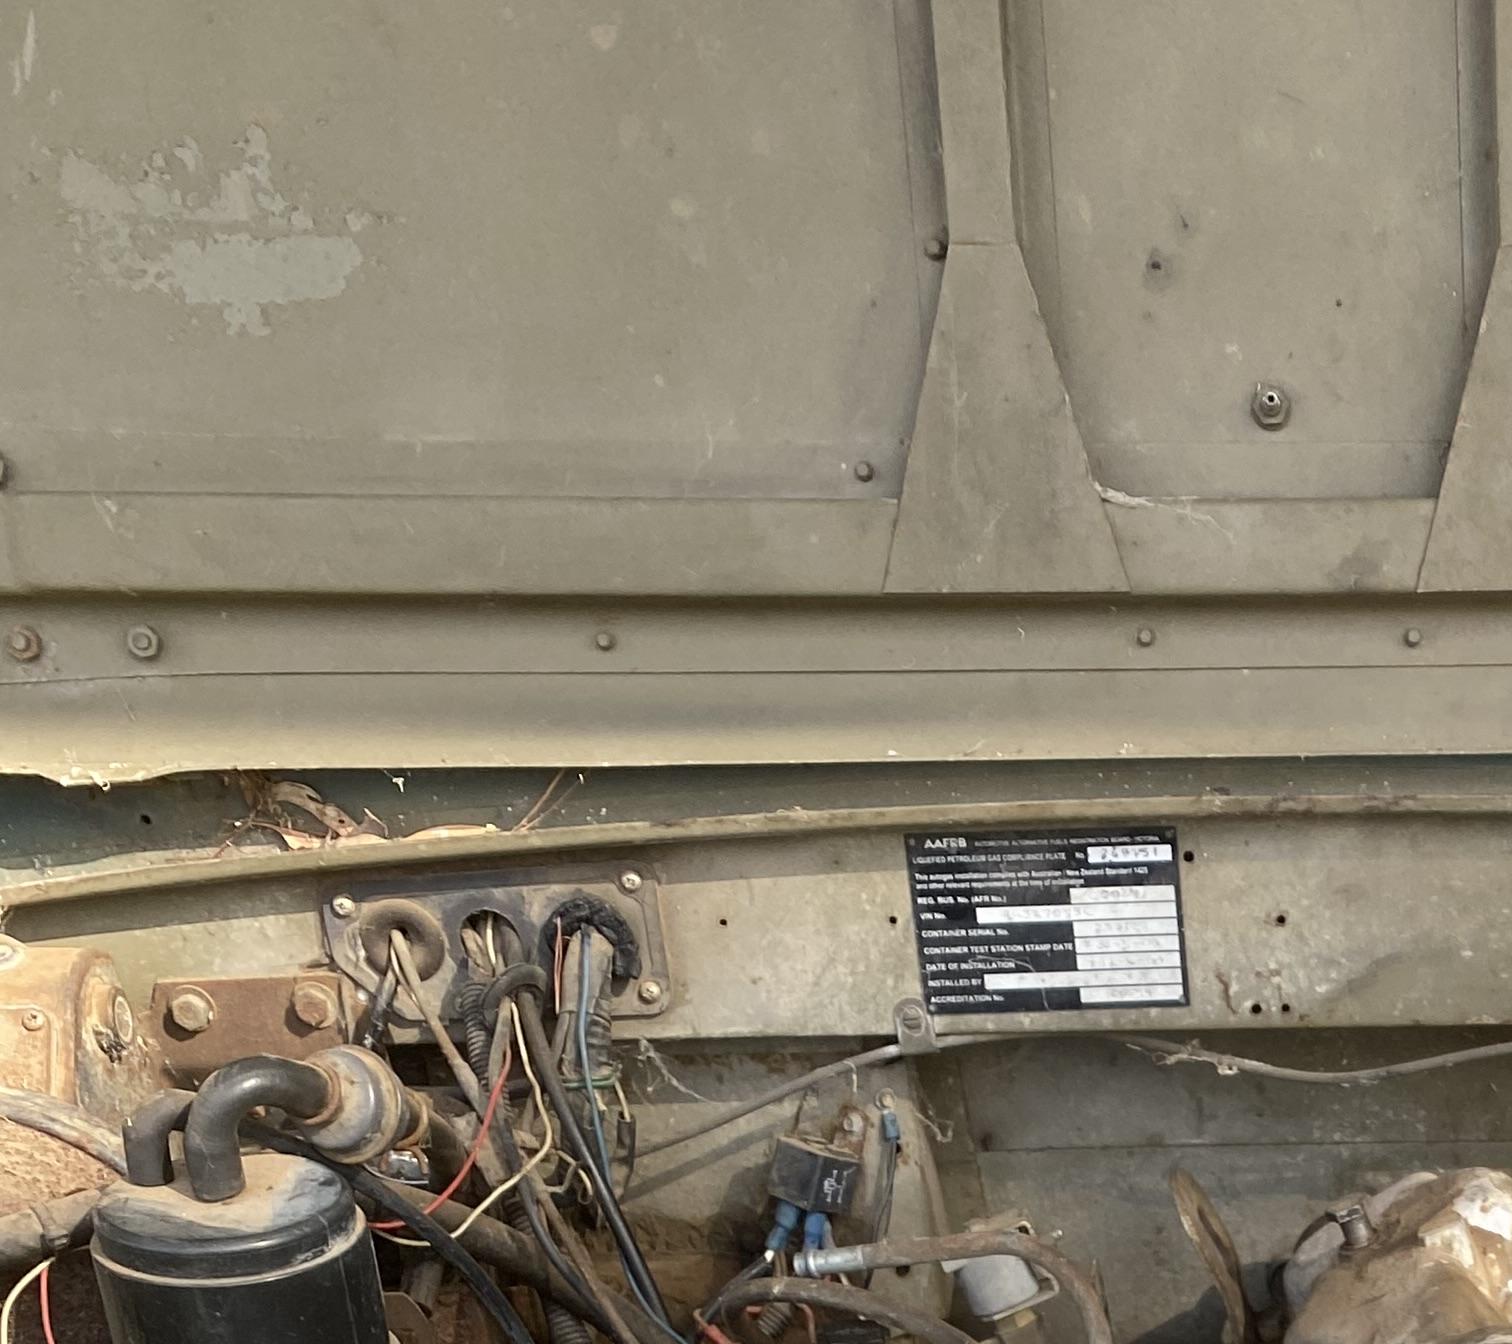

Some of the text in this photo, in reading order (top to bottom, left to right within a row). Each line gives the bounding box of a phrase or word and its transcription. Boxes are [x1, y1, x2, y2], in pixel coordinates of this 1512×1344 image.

[923, 837, 966, 848] AAFRB
[911, 855, 946, 864] LIQUEFIED
[946, 854, 985, 863] PETROLEUM
[987, 853, 1001, 862] GAS
[1001, 852, 1043, 861] COMPLIANCE
[1044, 851, 1065, 860] PLATE
[921, 928, 966, 937] CONTAINER
[967, 928, 995, 936] SERIAL
[923, 942, 1073, 955] CONTAINER TEST STATION STAMP DATE
[925, 961, 1015, 971] DATE OF INSTALLATION
[927, 978, 969, 986] INSTALLED
[929, 994, 991, 1003] ACCREDITATION
